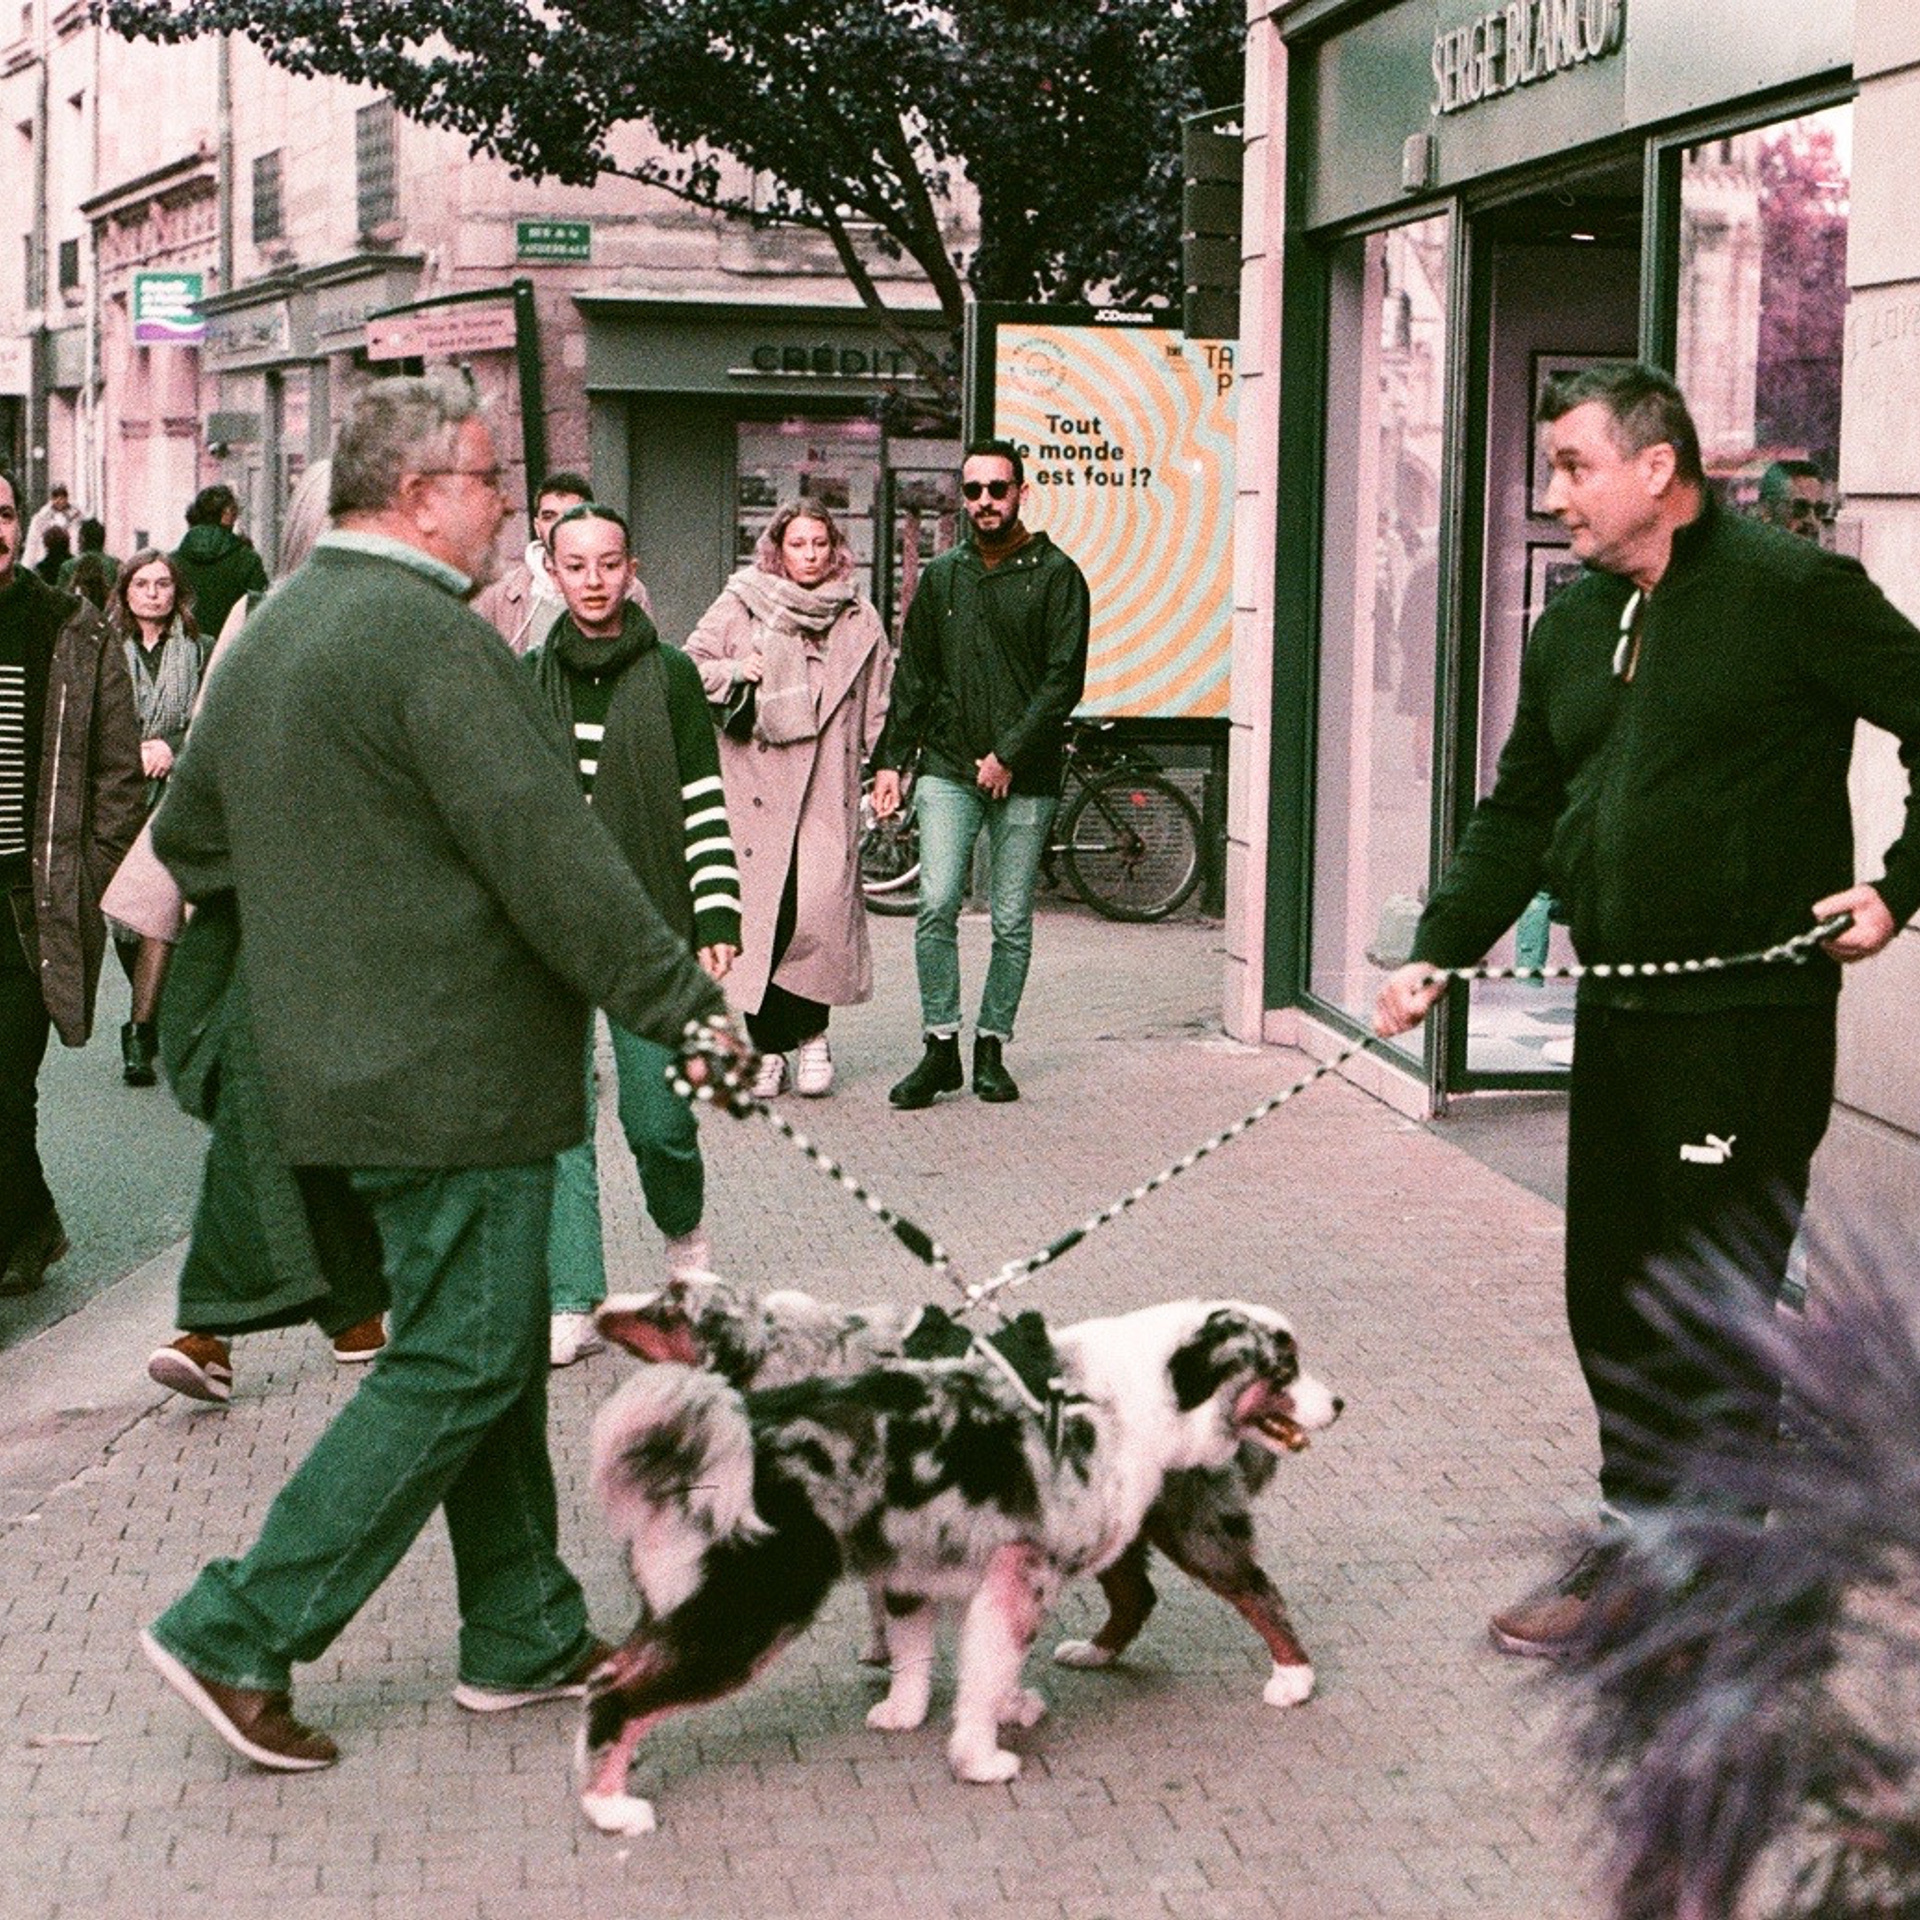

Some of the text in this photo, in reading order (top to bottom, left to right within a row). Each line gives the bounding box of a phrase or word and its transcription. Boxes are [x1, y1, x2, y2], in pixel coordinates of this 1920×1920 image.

[1430, 0, 1610, 117] SERGE BLANCO
[1045, 414, 1102, 436] Tout
[1039, 440, 1125, 461] monde
[1036, 467, 1076, 487] est
[1084, 465, 1125, 488] fou
